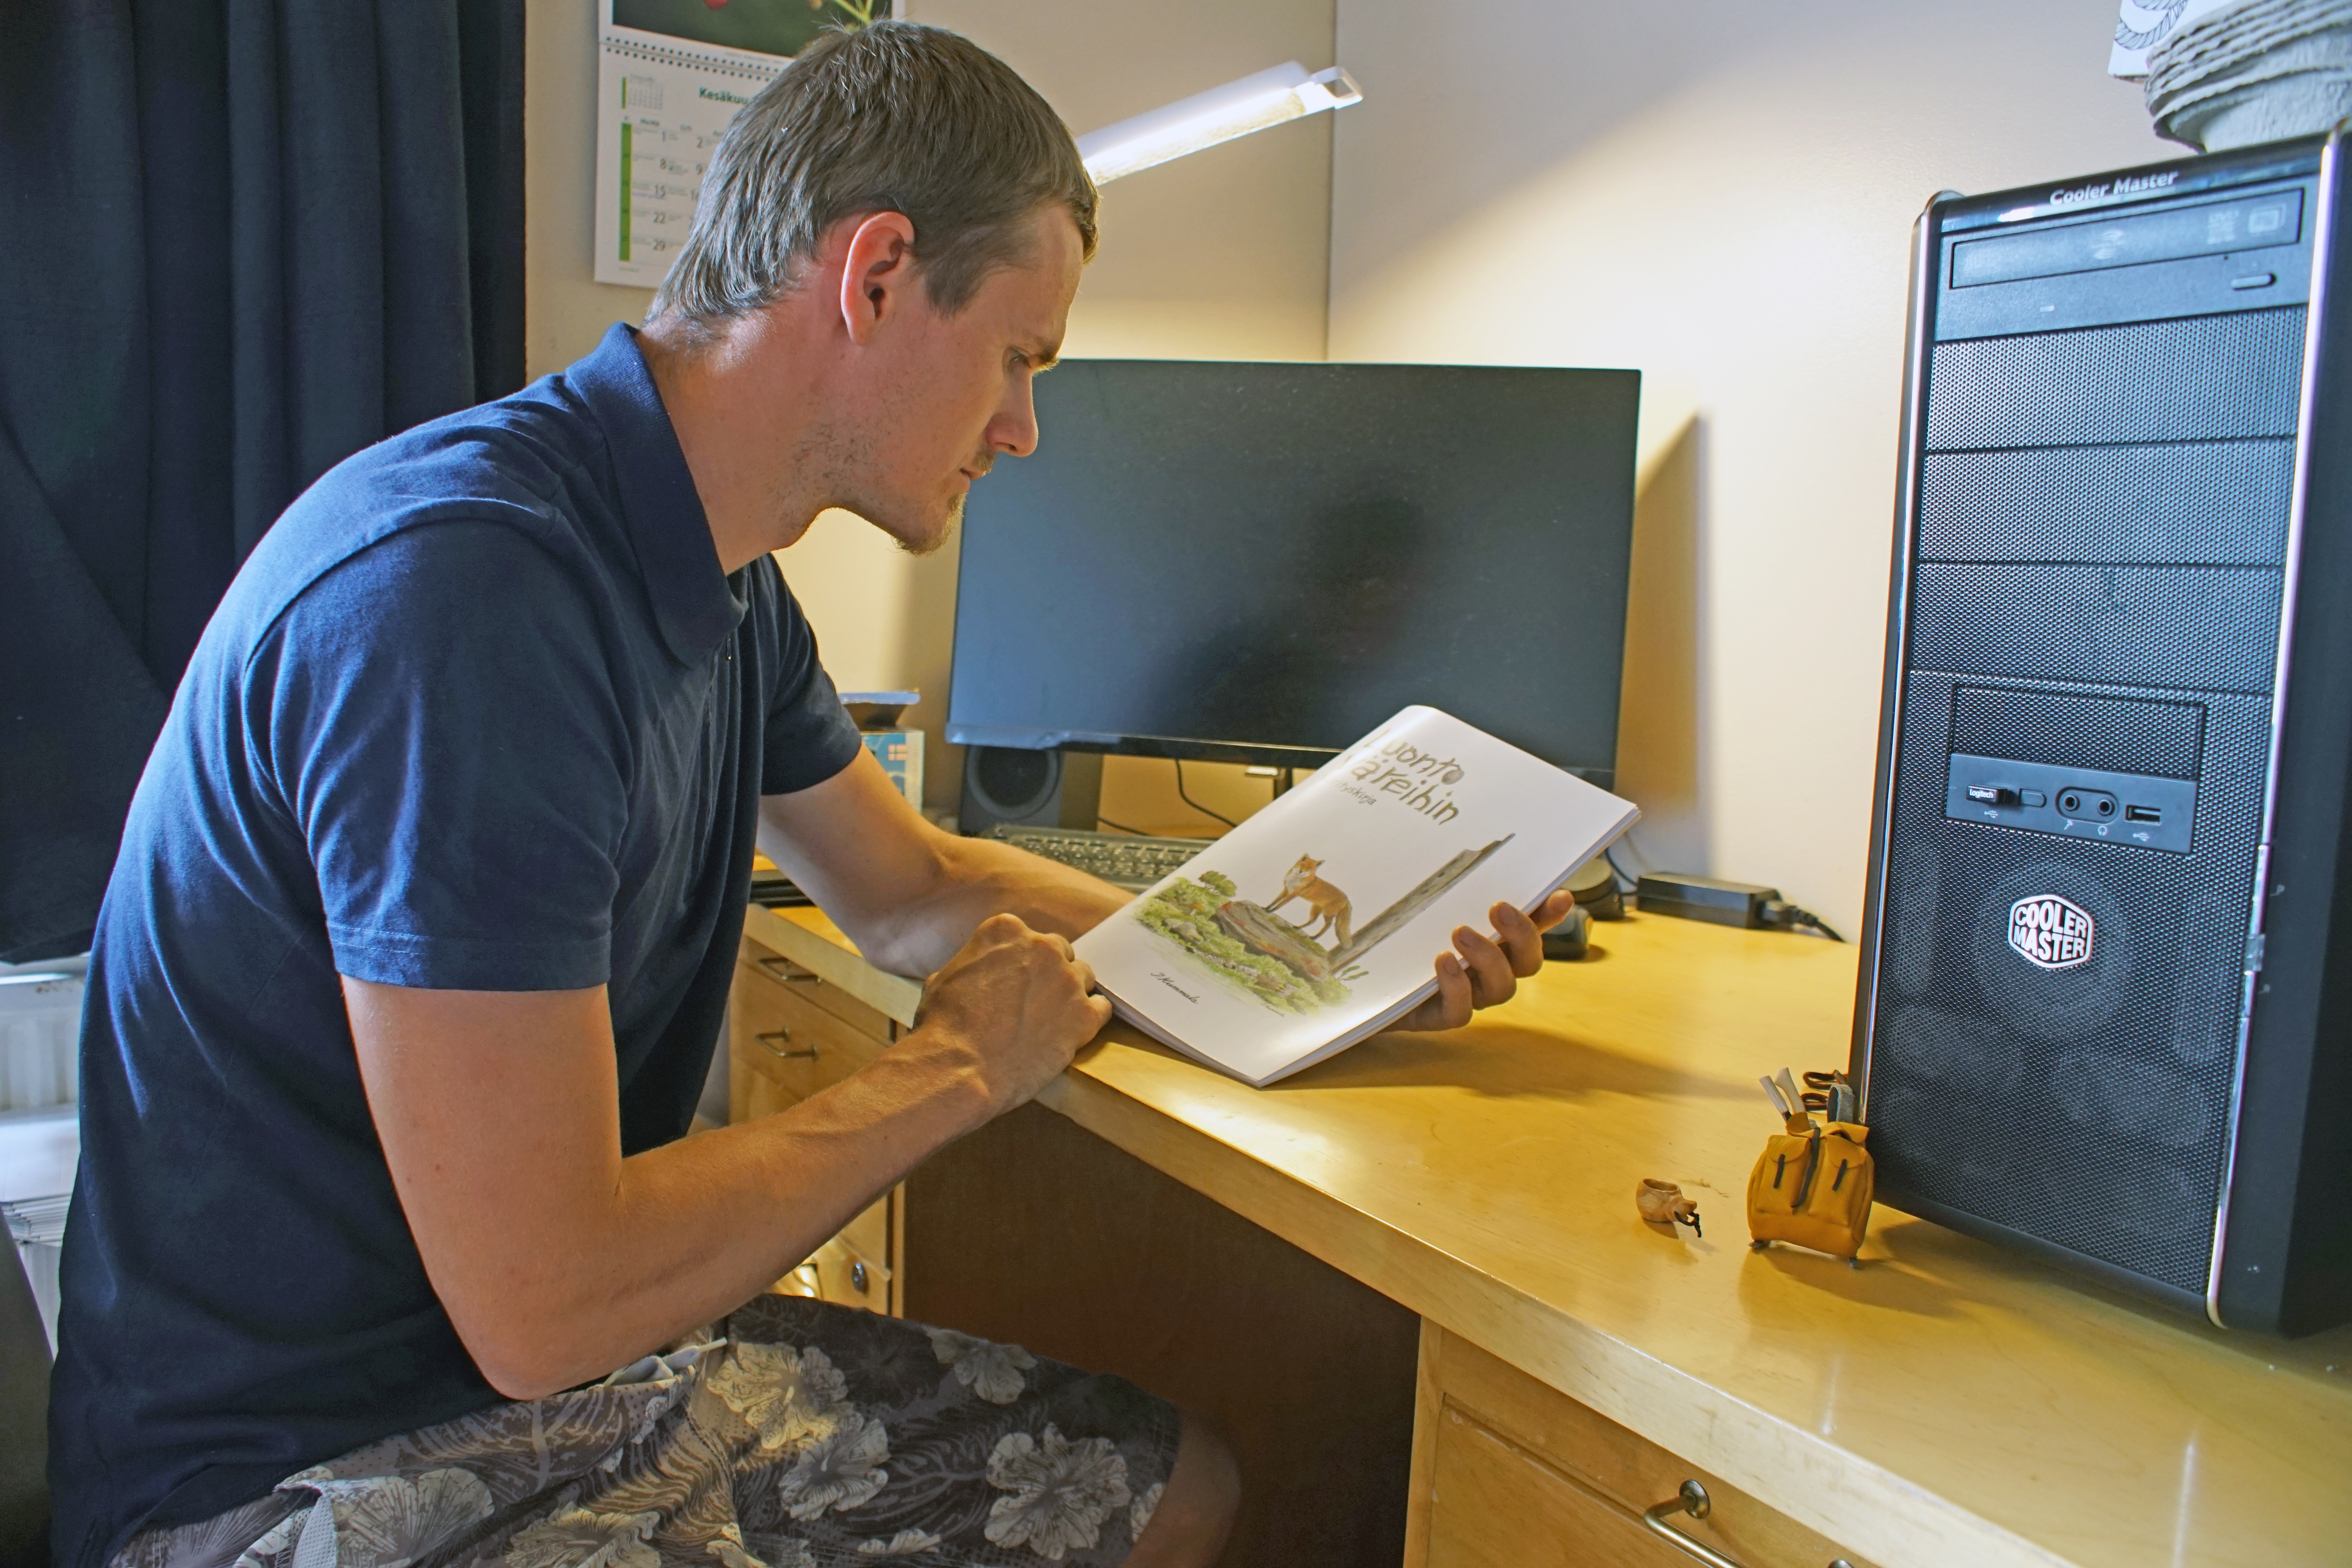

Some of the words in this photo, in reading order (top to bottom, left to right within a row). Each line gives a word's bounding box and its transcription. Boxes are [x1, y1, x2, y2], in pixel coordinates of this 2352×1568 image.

[2049, 183, 2111, 205] Cooler
[2113, 171, 2179, 195] Master
[653, 212, 665, 225] 22
[653, 239, 666, 251] 29
[1338, 755, 1459, 826] äreihin
[1969, 788, 1994, 799] Logitech
[2014, 901, 2088, 938] COOLER
[2013, 926, 2086, 961] MASTER
